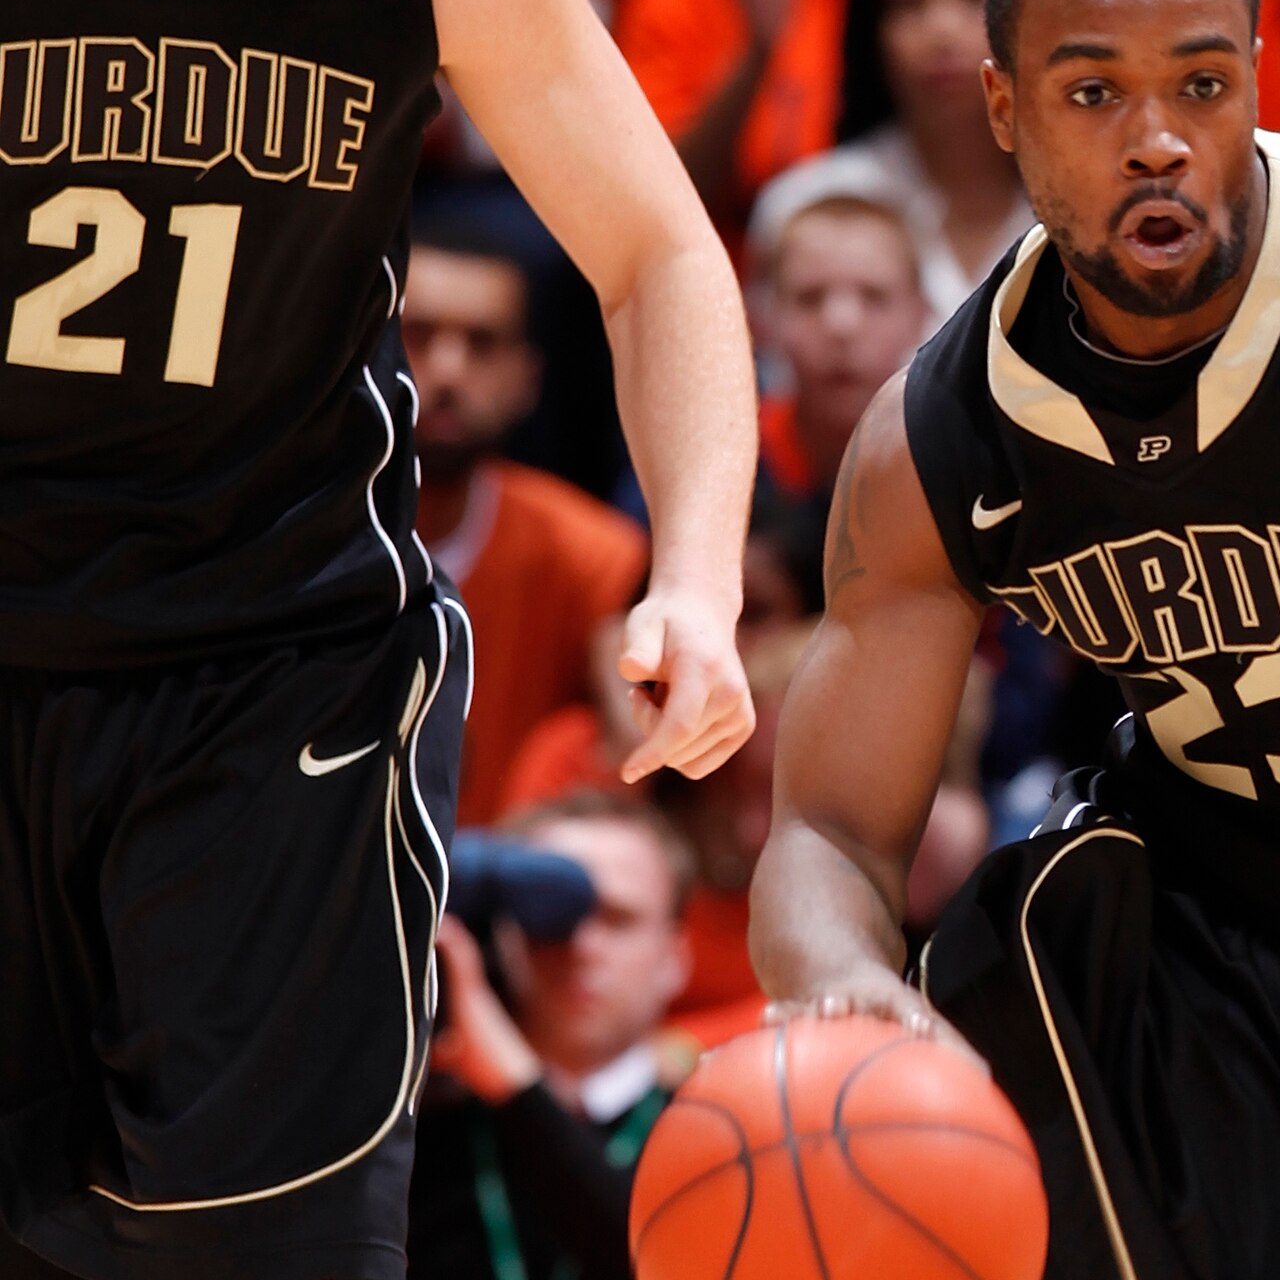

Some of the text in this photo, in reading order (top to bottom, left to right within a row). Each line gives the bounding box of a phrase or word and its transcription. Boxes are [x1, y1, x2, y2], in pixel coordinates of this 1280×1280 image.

[0, 36, 375, 191] URDUE
[6, 186, 243, 387] 21
[1137, 435, 1171, 462] P
